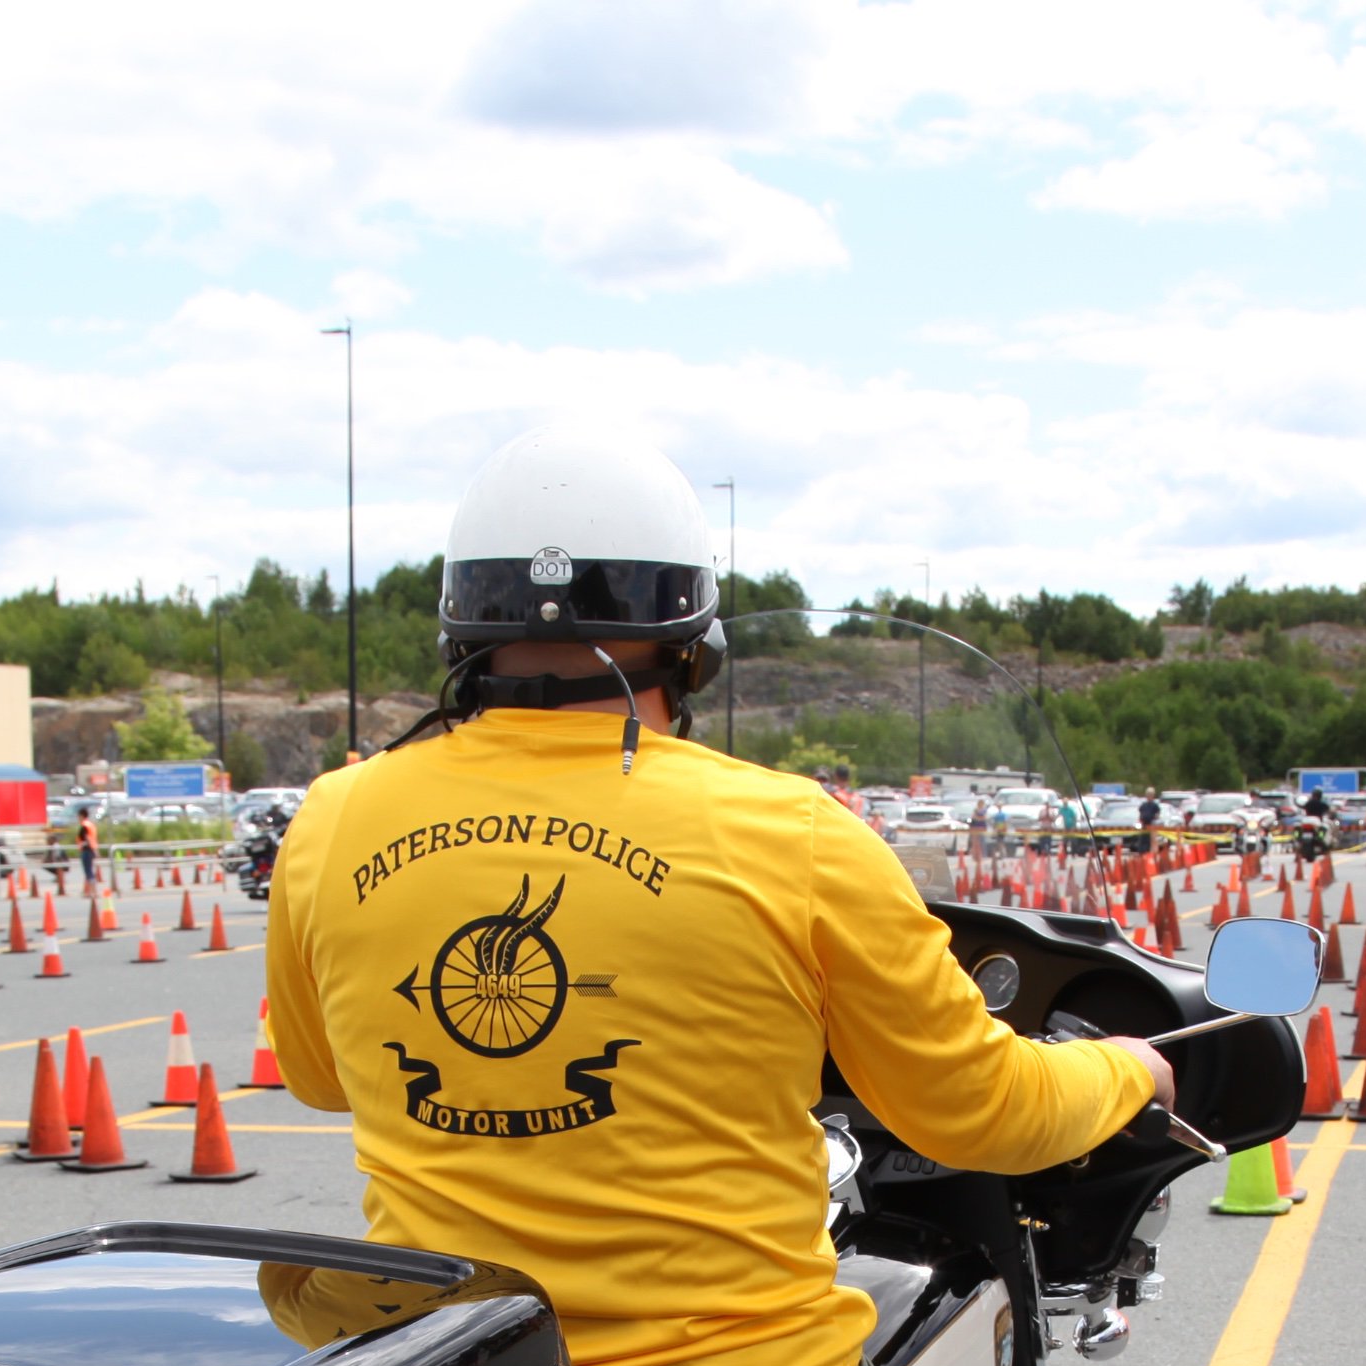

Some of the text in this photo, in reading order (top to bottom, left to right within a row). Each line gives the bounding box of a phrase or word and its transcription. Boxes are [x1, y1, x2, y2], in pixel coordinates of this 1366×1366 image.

[533, 562, 570, 577] DOT
[352, 814, 671, 906] PATERSON POLICE
[476, 974, 521, 999] 4649
[417, 1099, 597, 1135] MOTOR UNIT
